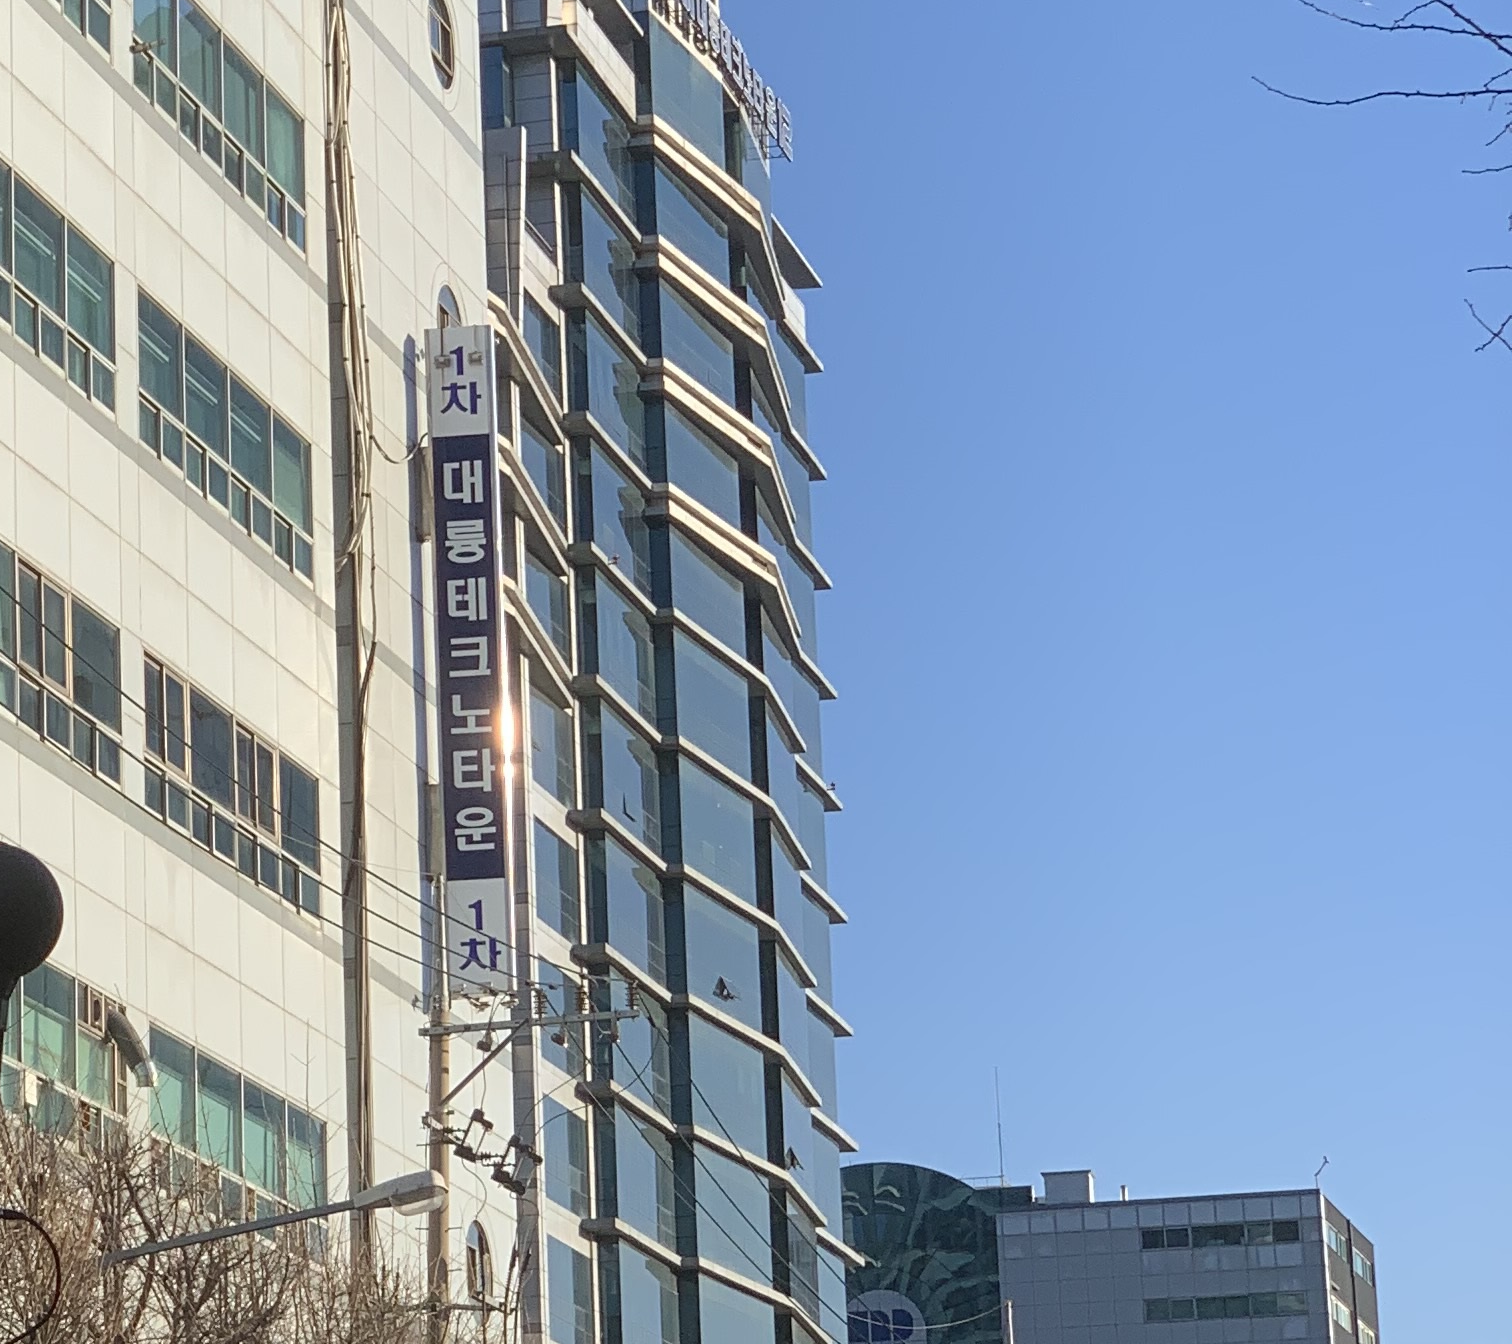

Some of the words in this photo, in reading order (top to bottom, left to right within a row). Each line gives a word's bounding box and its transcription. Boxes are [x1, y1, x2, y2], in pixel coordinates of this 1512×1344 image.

[440, 346, 482, 416] 1차
[442, 459, 498, 852] 대륭테크노타운
[459, 899, 503, 973] 1차
